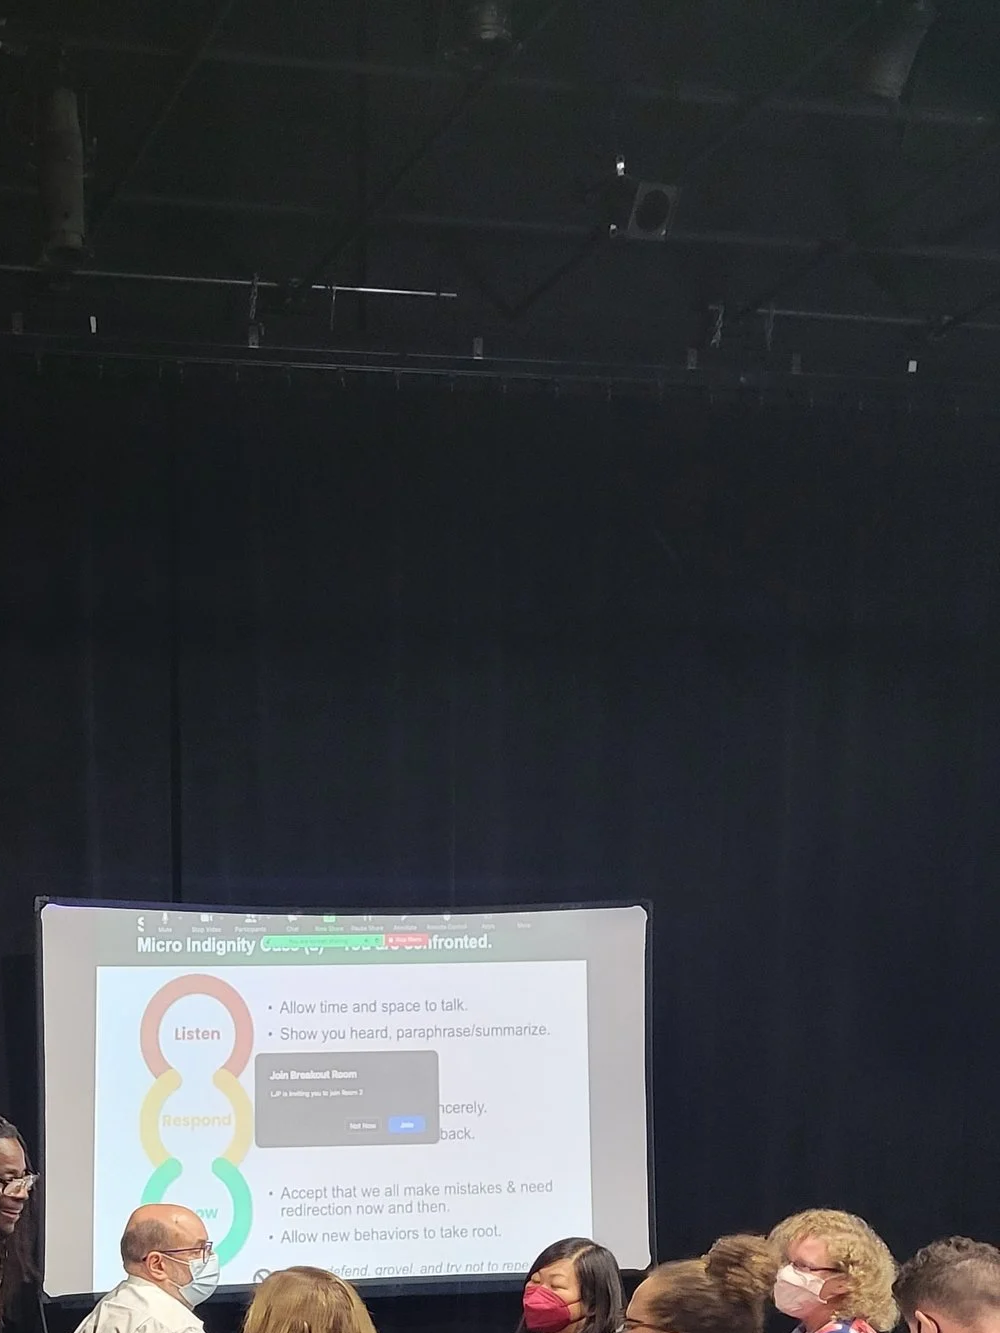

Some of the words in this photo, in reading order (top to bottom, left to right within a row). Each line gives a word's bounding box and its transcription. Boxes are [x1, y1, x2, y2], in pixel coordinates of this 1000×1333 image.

[137, 937, 183, 953] Micro
[186, 936, 256, 956] Indignity
[280, 1000, 316, 1014] Allow
[320, 1000, 348, 1013] time
[352, 999, 377, 1013] and
[382, 1001, 421, 1015] space
[425, 999, 437, 1012] to
[441, 998, 468, 1012] talk.
[174, 1026, 221, 1041] Listen
[280, 1027, 318, 1040] Show
[321, 1029, 346, 1043] you
[350, 1026, 392, 1040] heard,
[397, 1023, 551, 1041] paraphrase/summarize.
[269, 1071, 289, 1081] Join
[290, 1070, 330, 1080] Breakout
[332, 1069, 358, 1079] Room
[438, 1101, 487, 1116] ncerely.
[162, 1113, 232, 1131] Respond
[280, 1186, 328, 1200] Accept
[332, 1185, 357, 1198] that
[361, 1186, 381, 1198] we
[384, 1184, 399, 1197] all
[403, 1182, 440, 1197] make
[444, 1182, 502, 1196] mistakes
[506, 1180, 516, 1194] &
[520, 1179, 553, 1193] need
[281, 1203, 352, 1217] redirection
[356, 1204, 384, 1215] now
[388, 1200, 413, 1214] and
[417, 1200, 450, 1213] then.
[280, 1229, 318, 1243] Allow
[321, 1231, 351, 1243] new
[354, 1227, 420, 1241] behaviors
[423, 1226, 436, 1240] to
[440, 1225, 468, 1239] take
[472, 1224, 502, 1238] root.
[420, 1262, 443, 1274] and
[446, 1261, 462, 1273] try
[465, 1261, 484, 1273] not
[487, 1261, 499, 1272] to
[502, 1262, 529, 1272] repe
